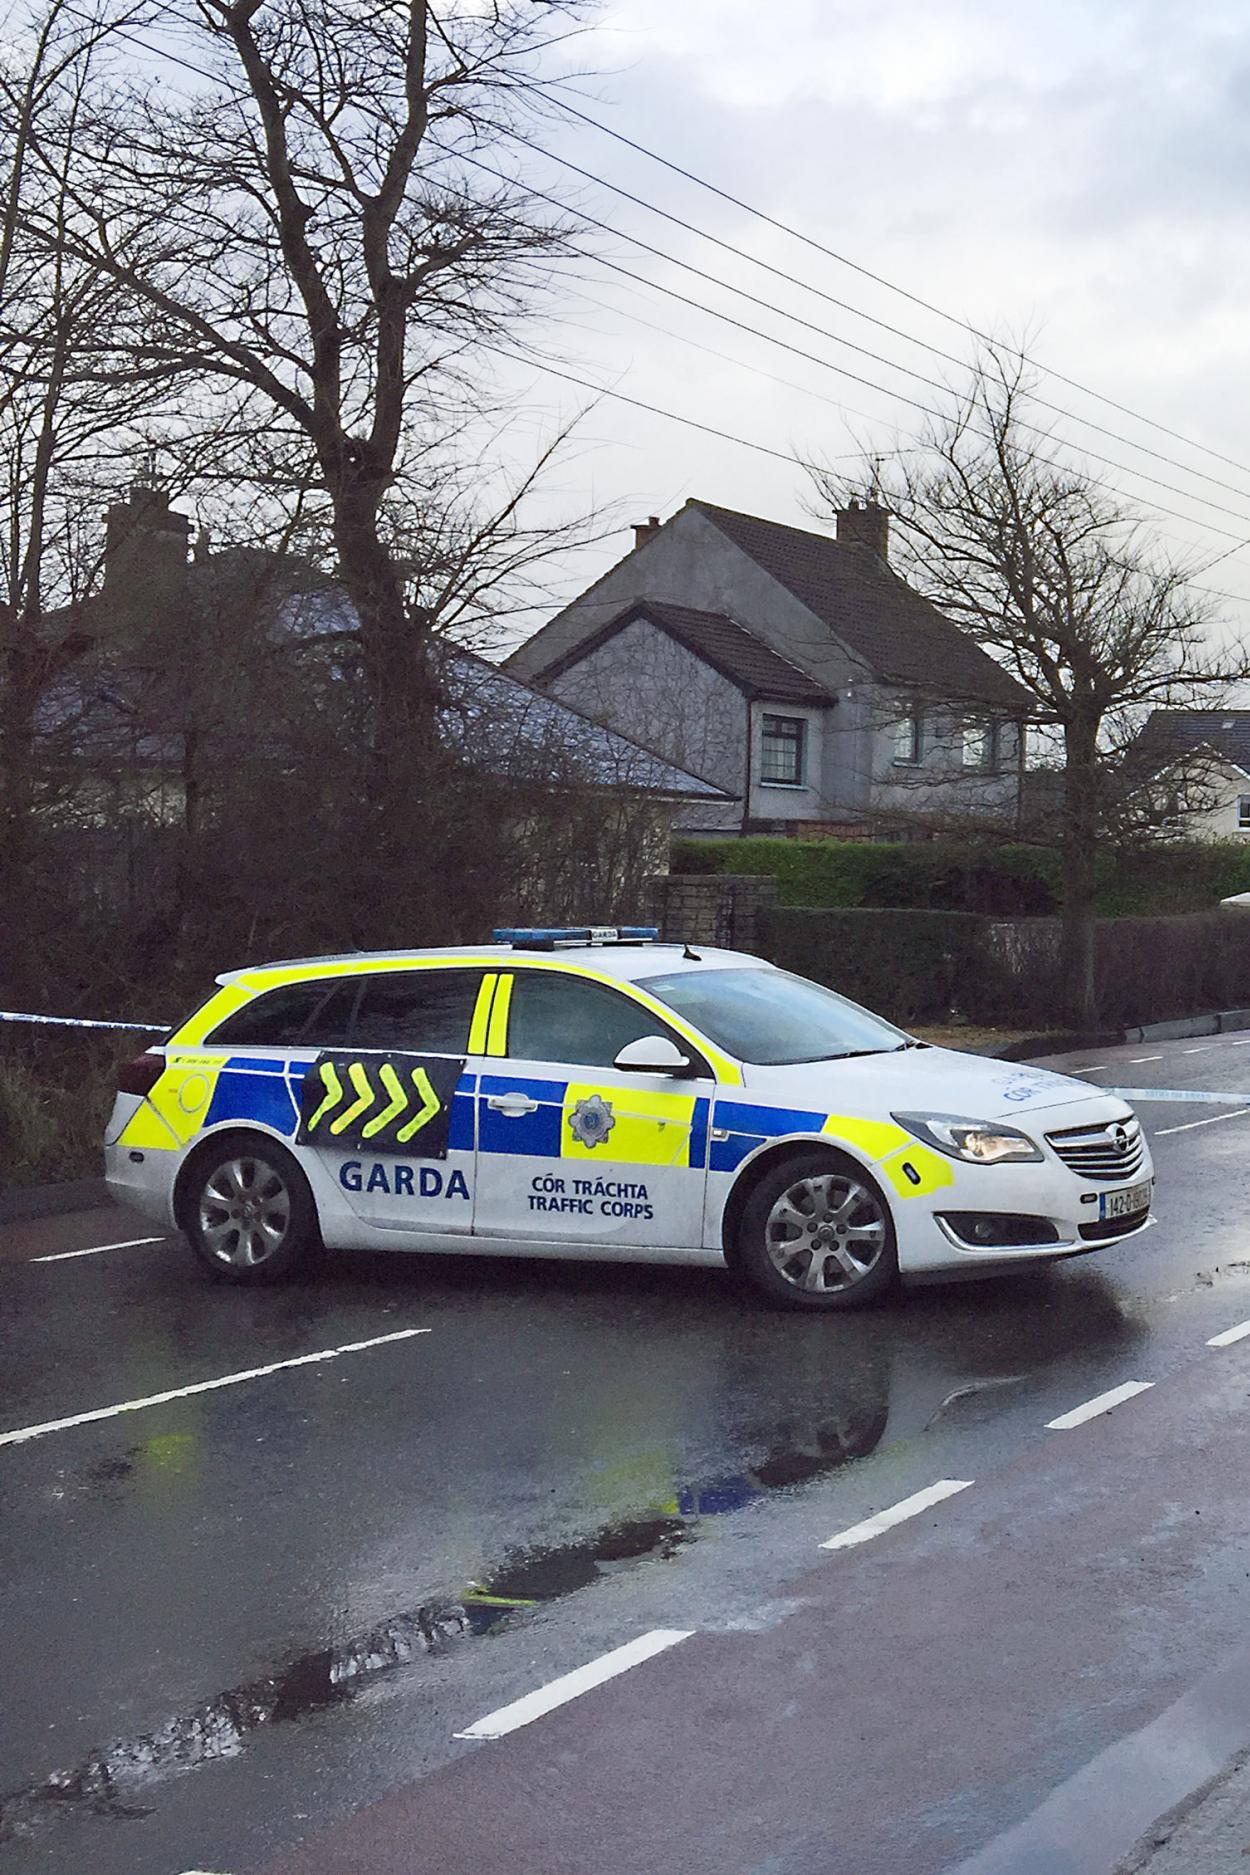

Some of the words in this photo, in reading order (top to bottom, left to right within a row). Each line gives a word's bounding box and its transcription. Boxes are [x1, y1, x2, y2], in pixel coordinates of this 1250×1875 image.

[339, 1160, 470, 1200] GARDA
[532, 1172, 565, 1194] CÓR
[572, 1176, 648, 1200] TRÁCHTA
[528, 1195, 594, 1215] TRAFFIC
[600, 1200, 654, 1220] CORPS
